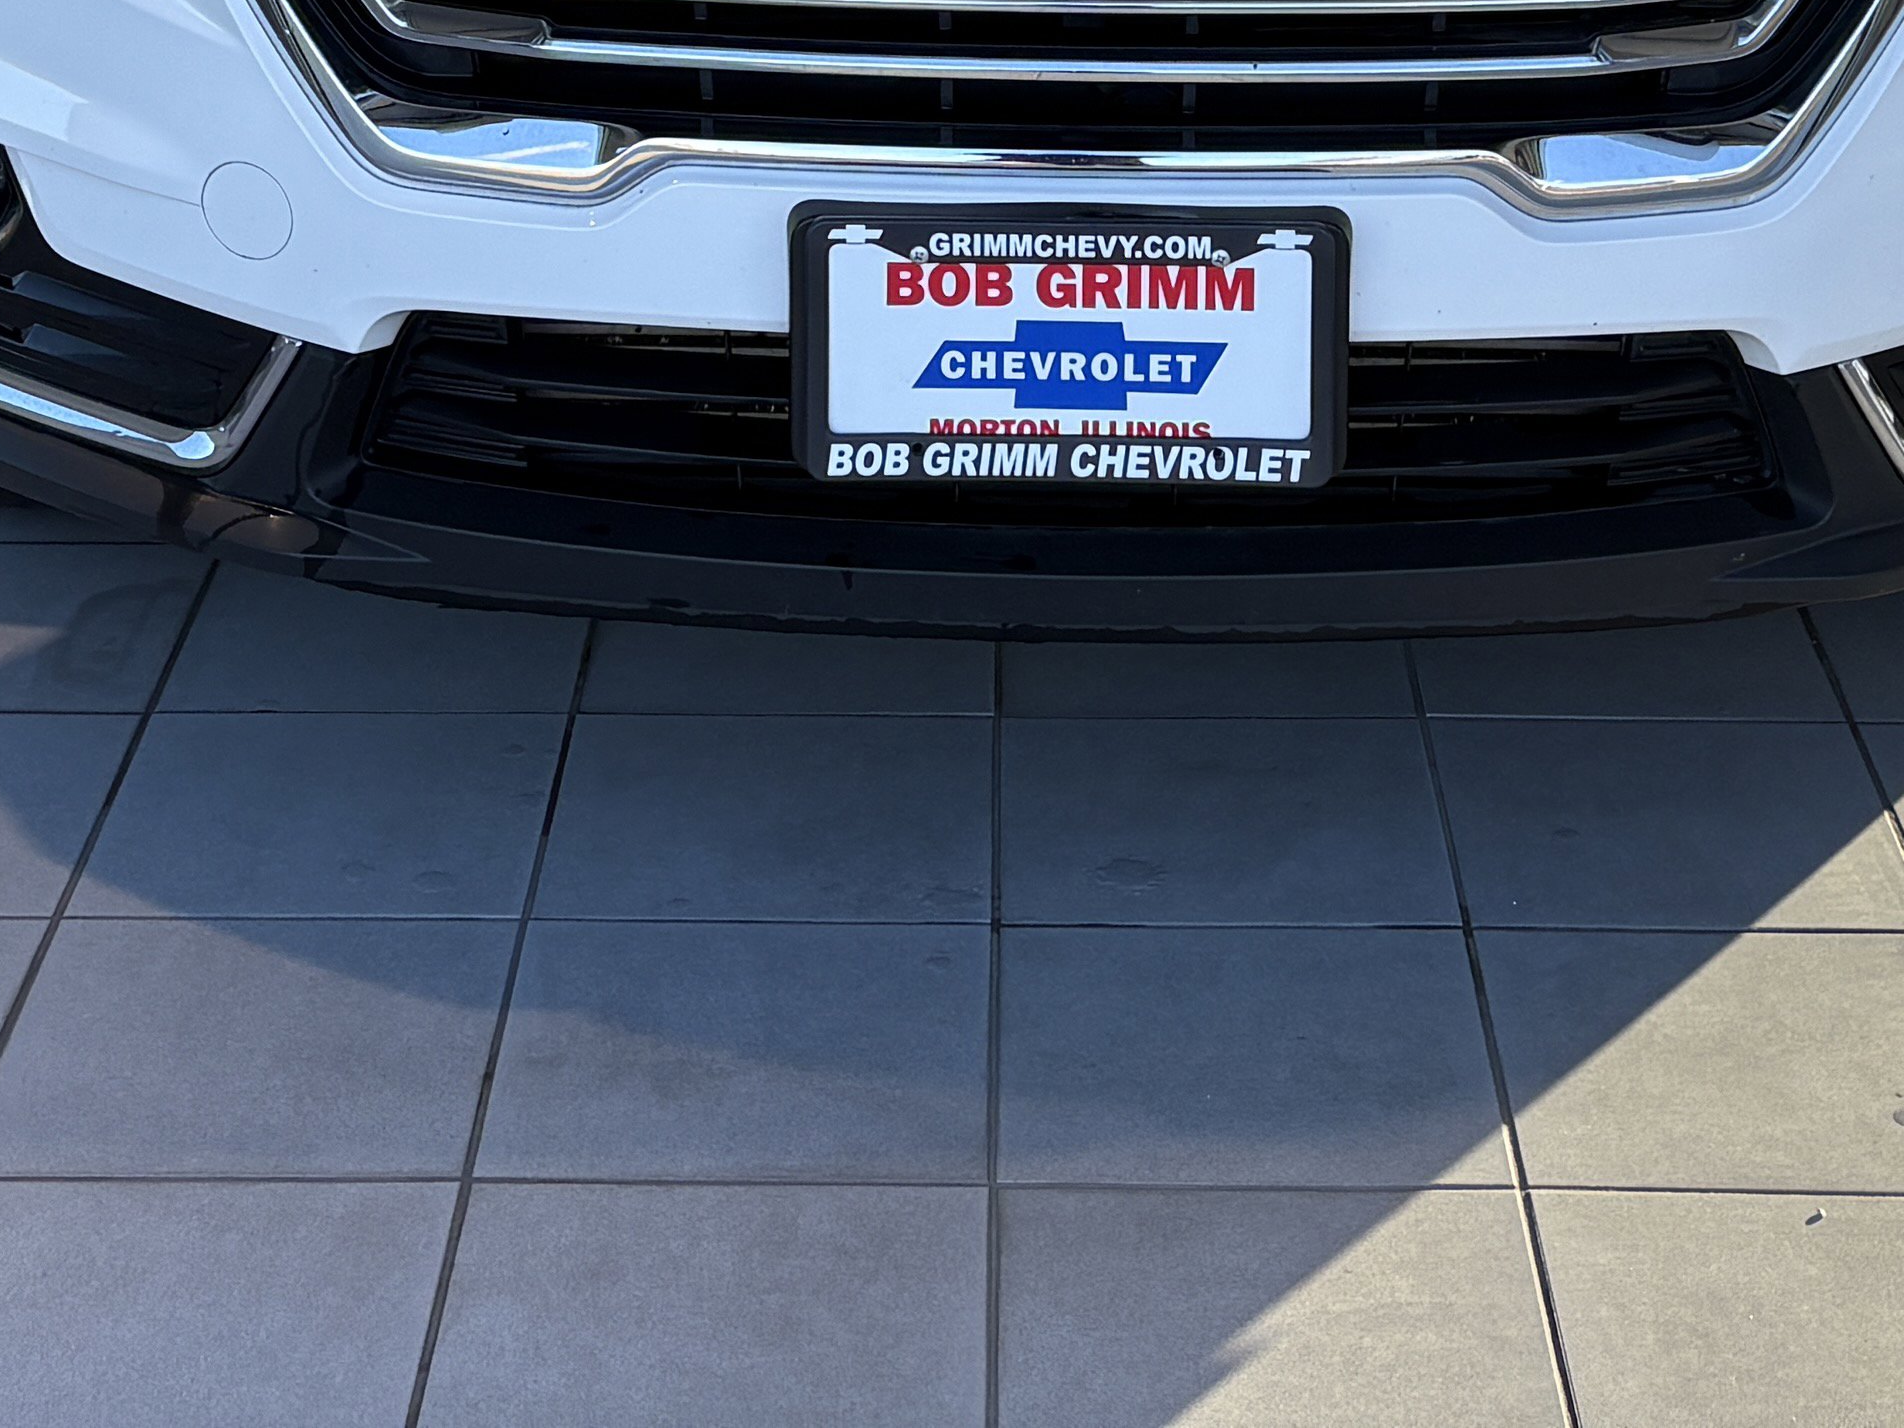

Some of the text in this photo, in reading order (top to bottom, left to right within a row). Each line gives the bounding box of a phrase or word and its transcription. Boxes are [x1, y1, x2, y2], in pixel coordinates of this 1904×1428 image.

[928, 232, 1213, 262] GRIMMCHEVY.COM
[885, 262, 1256, 312] BOB GRIMM
[940, 349, 1198, 385] CHEVROLET
[1081, 419, 1212, 439] ILLINOIS
[827, 442, 1311, 485] BOB GRIMM CHEVROLET
